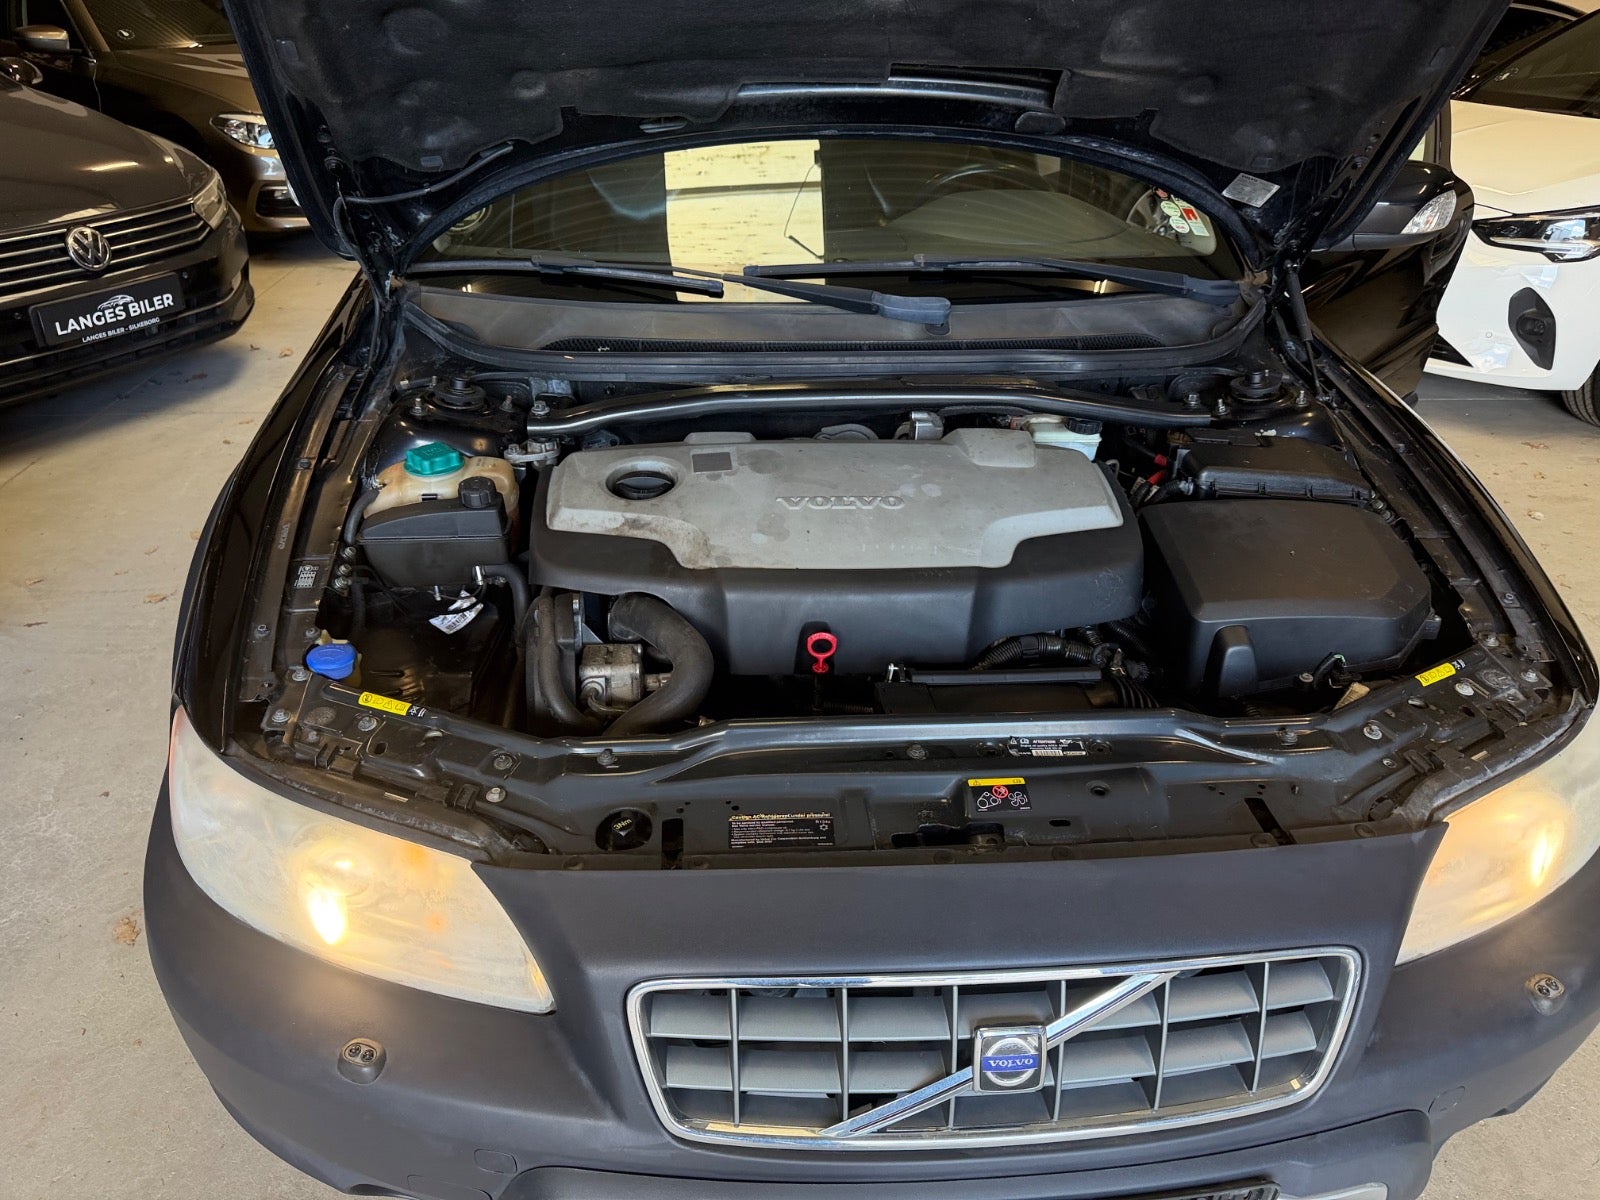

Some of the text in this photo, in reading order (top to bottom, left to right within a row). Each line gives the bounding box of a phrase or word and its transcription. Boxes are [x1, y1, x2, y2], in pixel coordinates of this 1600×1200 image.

[55, 293, 174, 335] LANGES BILER
[82, 332, 107, 343] LANGES
[107, 327, 125, 337] BILER
[128, 317, 160, 331] SILKEBORG
[776, 496, 906, 510] VOLVO
[988, 1058, 1034, 1067] VOLVO
